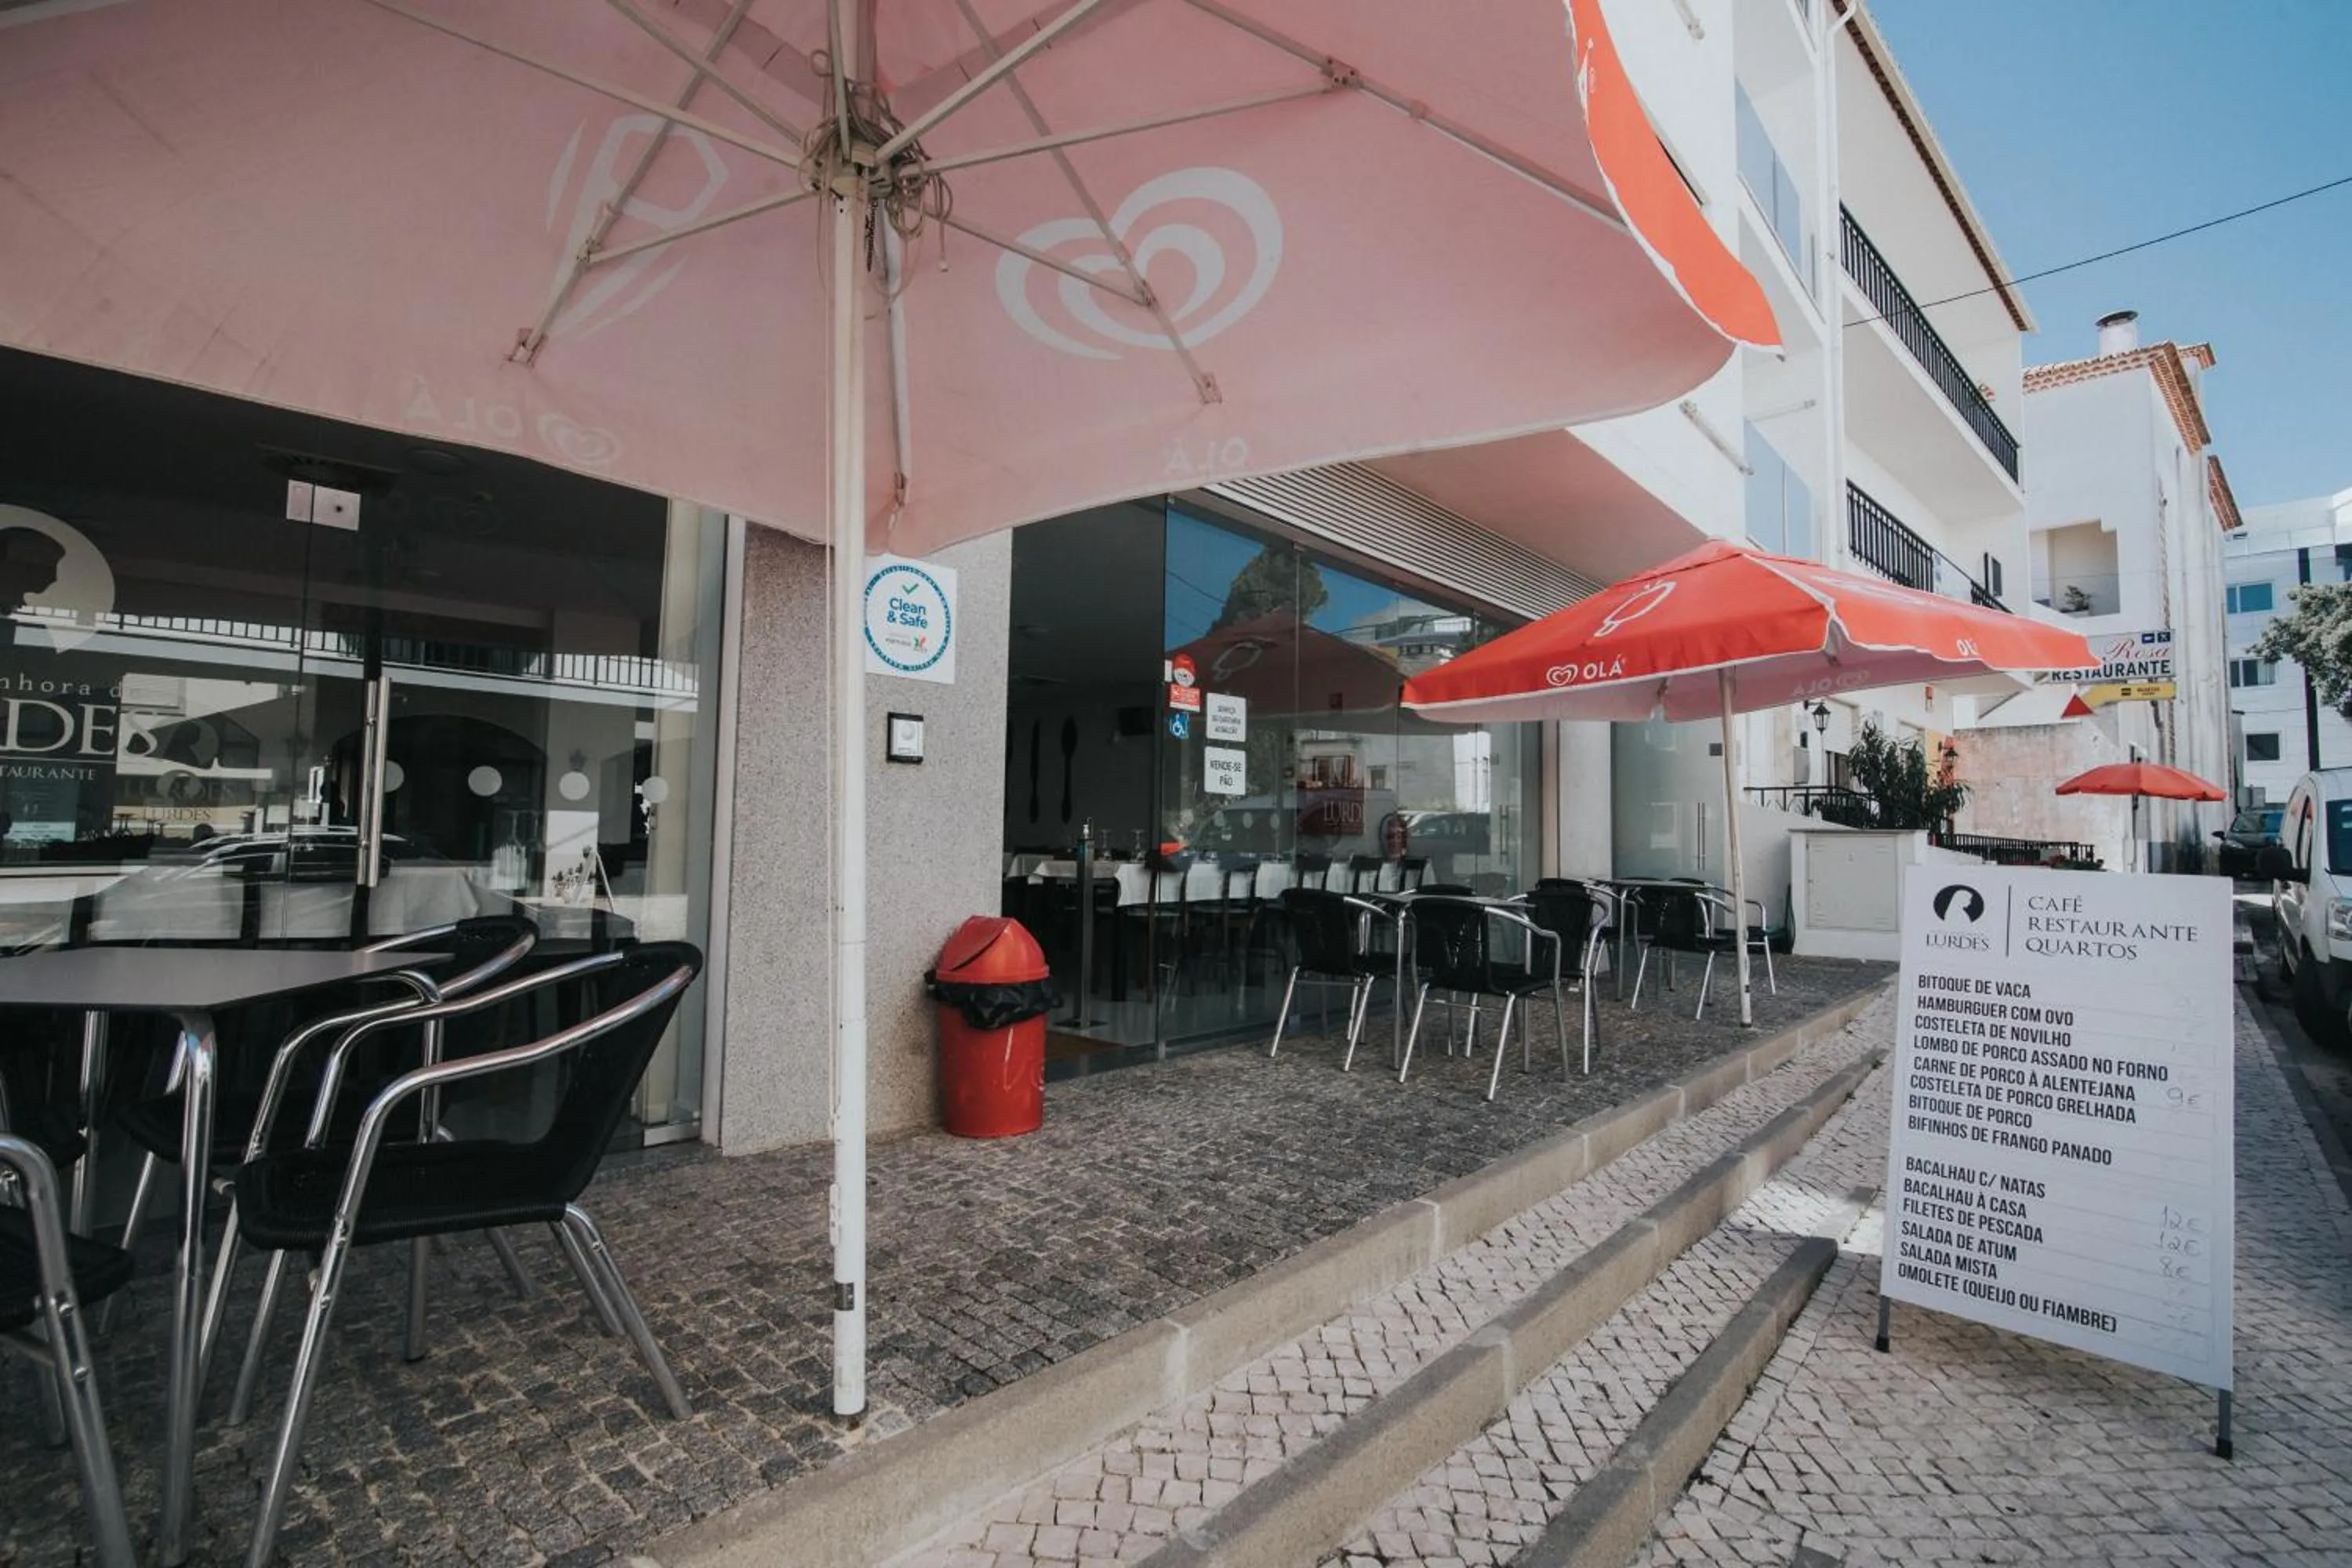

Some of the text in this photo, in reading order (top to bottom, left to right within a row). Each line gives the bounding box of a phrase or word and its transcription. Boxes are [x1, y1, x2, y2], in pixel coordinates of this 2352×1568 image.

[887, 611, 927, 629] & Safe
[890, 597, 926, 615] Clean
[2104, 638, 2169, 662] Rosa
[1583, 654, 1623, 680] OLÁ
[2052, 659, 2171, 681] RESTAURANTE
[2028, 895, 2082, 913] CAFÉ
[1926, 933, 1990, 952] LURDES
[2027, 916, 2198, 942] RESTAURANTE
[2025, 938, 2138, 960] QUARTOS
[1918, 975, 2031, 998] BITOQUE DE VACA
[1917, 995, 2074, 1026] HAMBURGUER COM OVO
[1915, 1015, 2071, 1047] COSTELETA DE NOVILHO
[1914, 1034, 2169, 1082] LOMBO DE PORCO ASSADO NO FORNO
[1914, 1056, 1956, 1075] CARNE
[1960, 1062, 1976, 1078] DE
[1980, 1065, 2025, 1085] PORCO
[2042, 1075, 2136, 1102] ALENTEJANA
[1909, 1094, 2033, 1129] BITOQUE DE PORCO
[1910, 1075, 2136, 1123] COSTELETA DE PORCO GRELHADA
[1908, 1115, 2112, 1166] BIFINHOS DE FRANGO PANADO
[1906, 1156, 2045, 1199] BACALHAU C/ NATAS
[1904, 1178, 1973, 1207] BACALHAU
[1990, 1197, 2027, 1219] CASA
[1903, 1197, 2043, 1244] FILETES DE PESCADA
[1901, 1221, 2017, 1261] SALADA DE ATUM
[1900, 1241, 1998, 1280] SALADA MISTA
[1898, 1263, 2118, 1334] OMOLETE (QUEIJO OU FIAMBRE)
